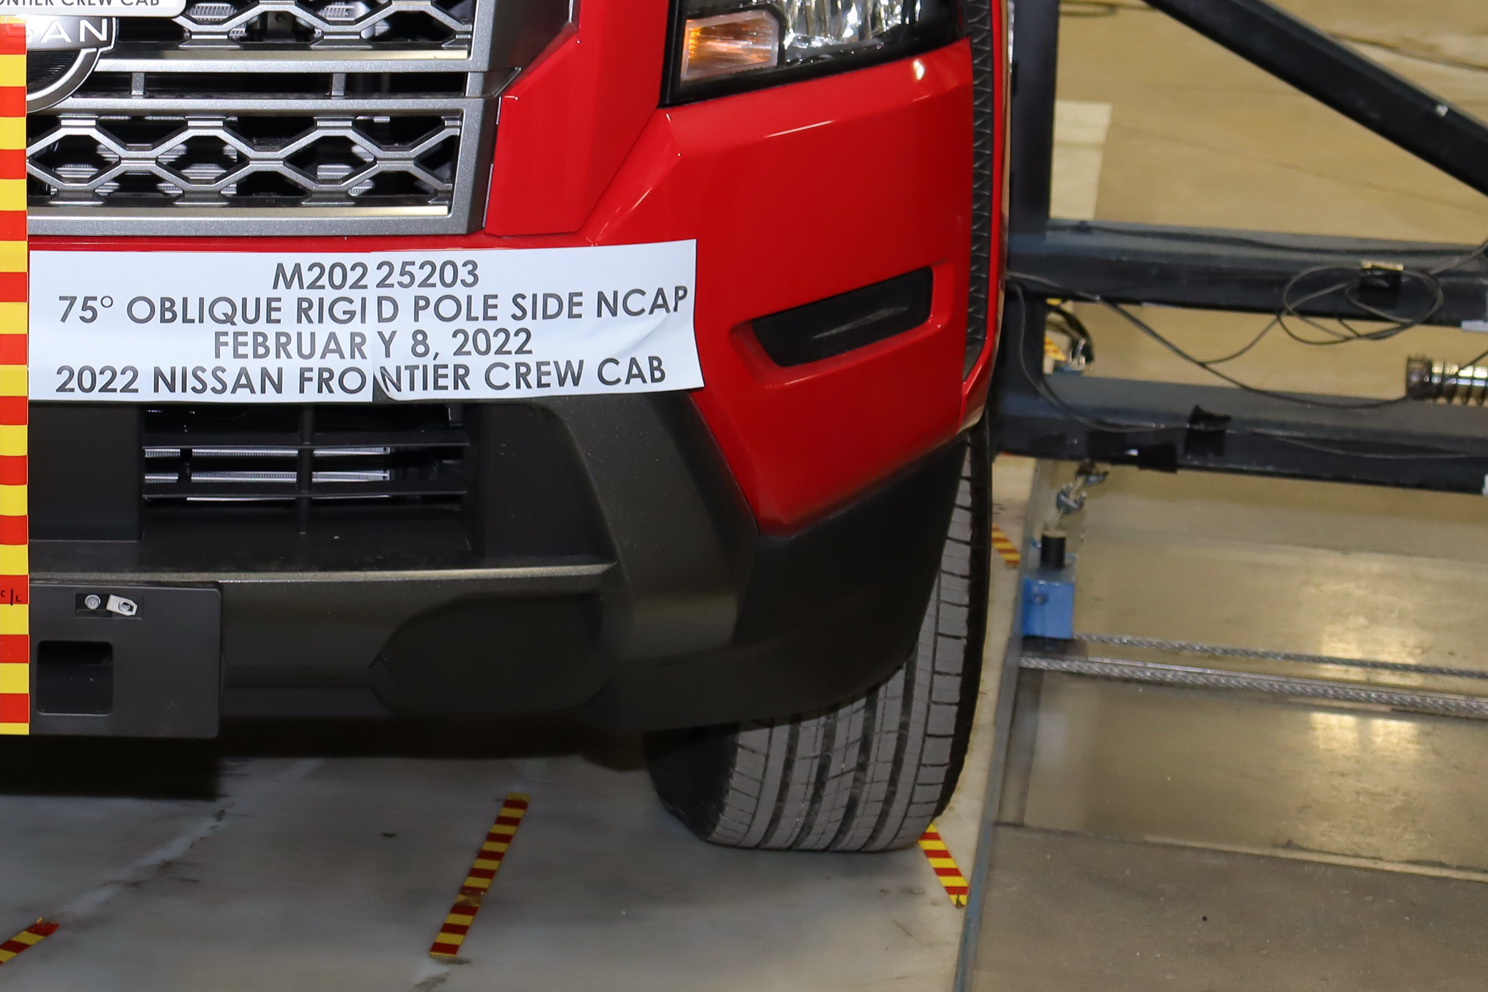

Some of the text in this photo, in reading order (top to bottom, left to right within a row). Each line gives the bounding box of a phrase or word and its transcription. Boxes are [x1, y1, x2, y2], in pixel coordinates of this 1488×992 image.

[272, 260, 479, 290] M20225203
[127, 296, 281, 326] OBLIQUE
[297, 296, 399, 324] RIGID
[414, 294, 498, 322] POLE
[511, 292, 583, 321] SIDE
[597, 286, 687, 318] NCAP
[215, 327, 532, 361] FEBRUARY 8, 2022
[56, 356, 665, 394] 2022 NISSAN FRONTIER CREW CAB
